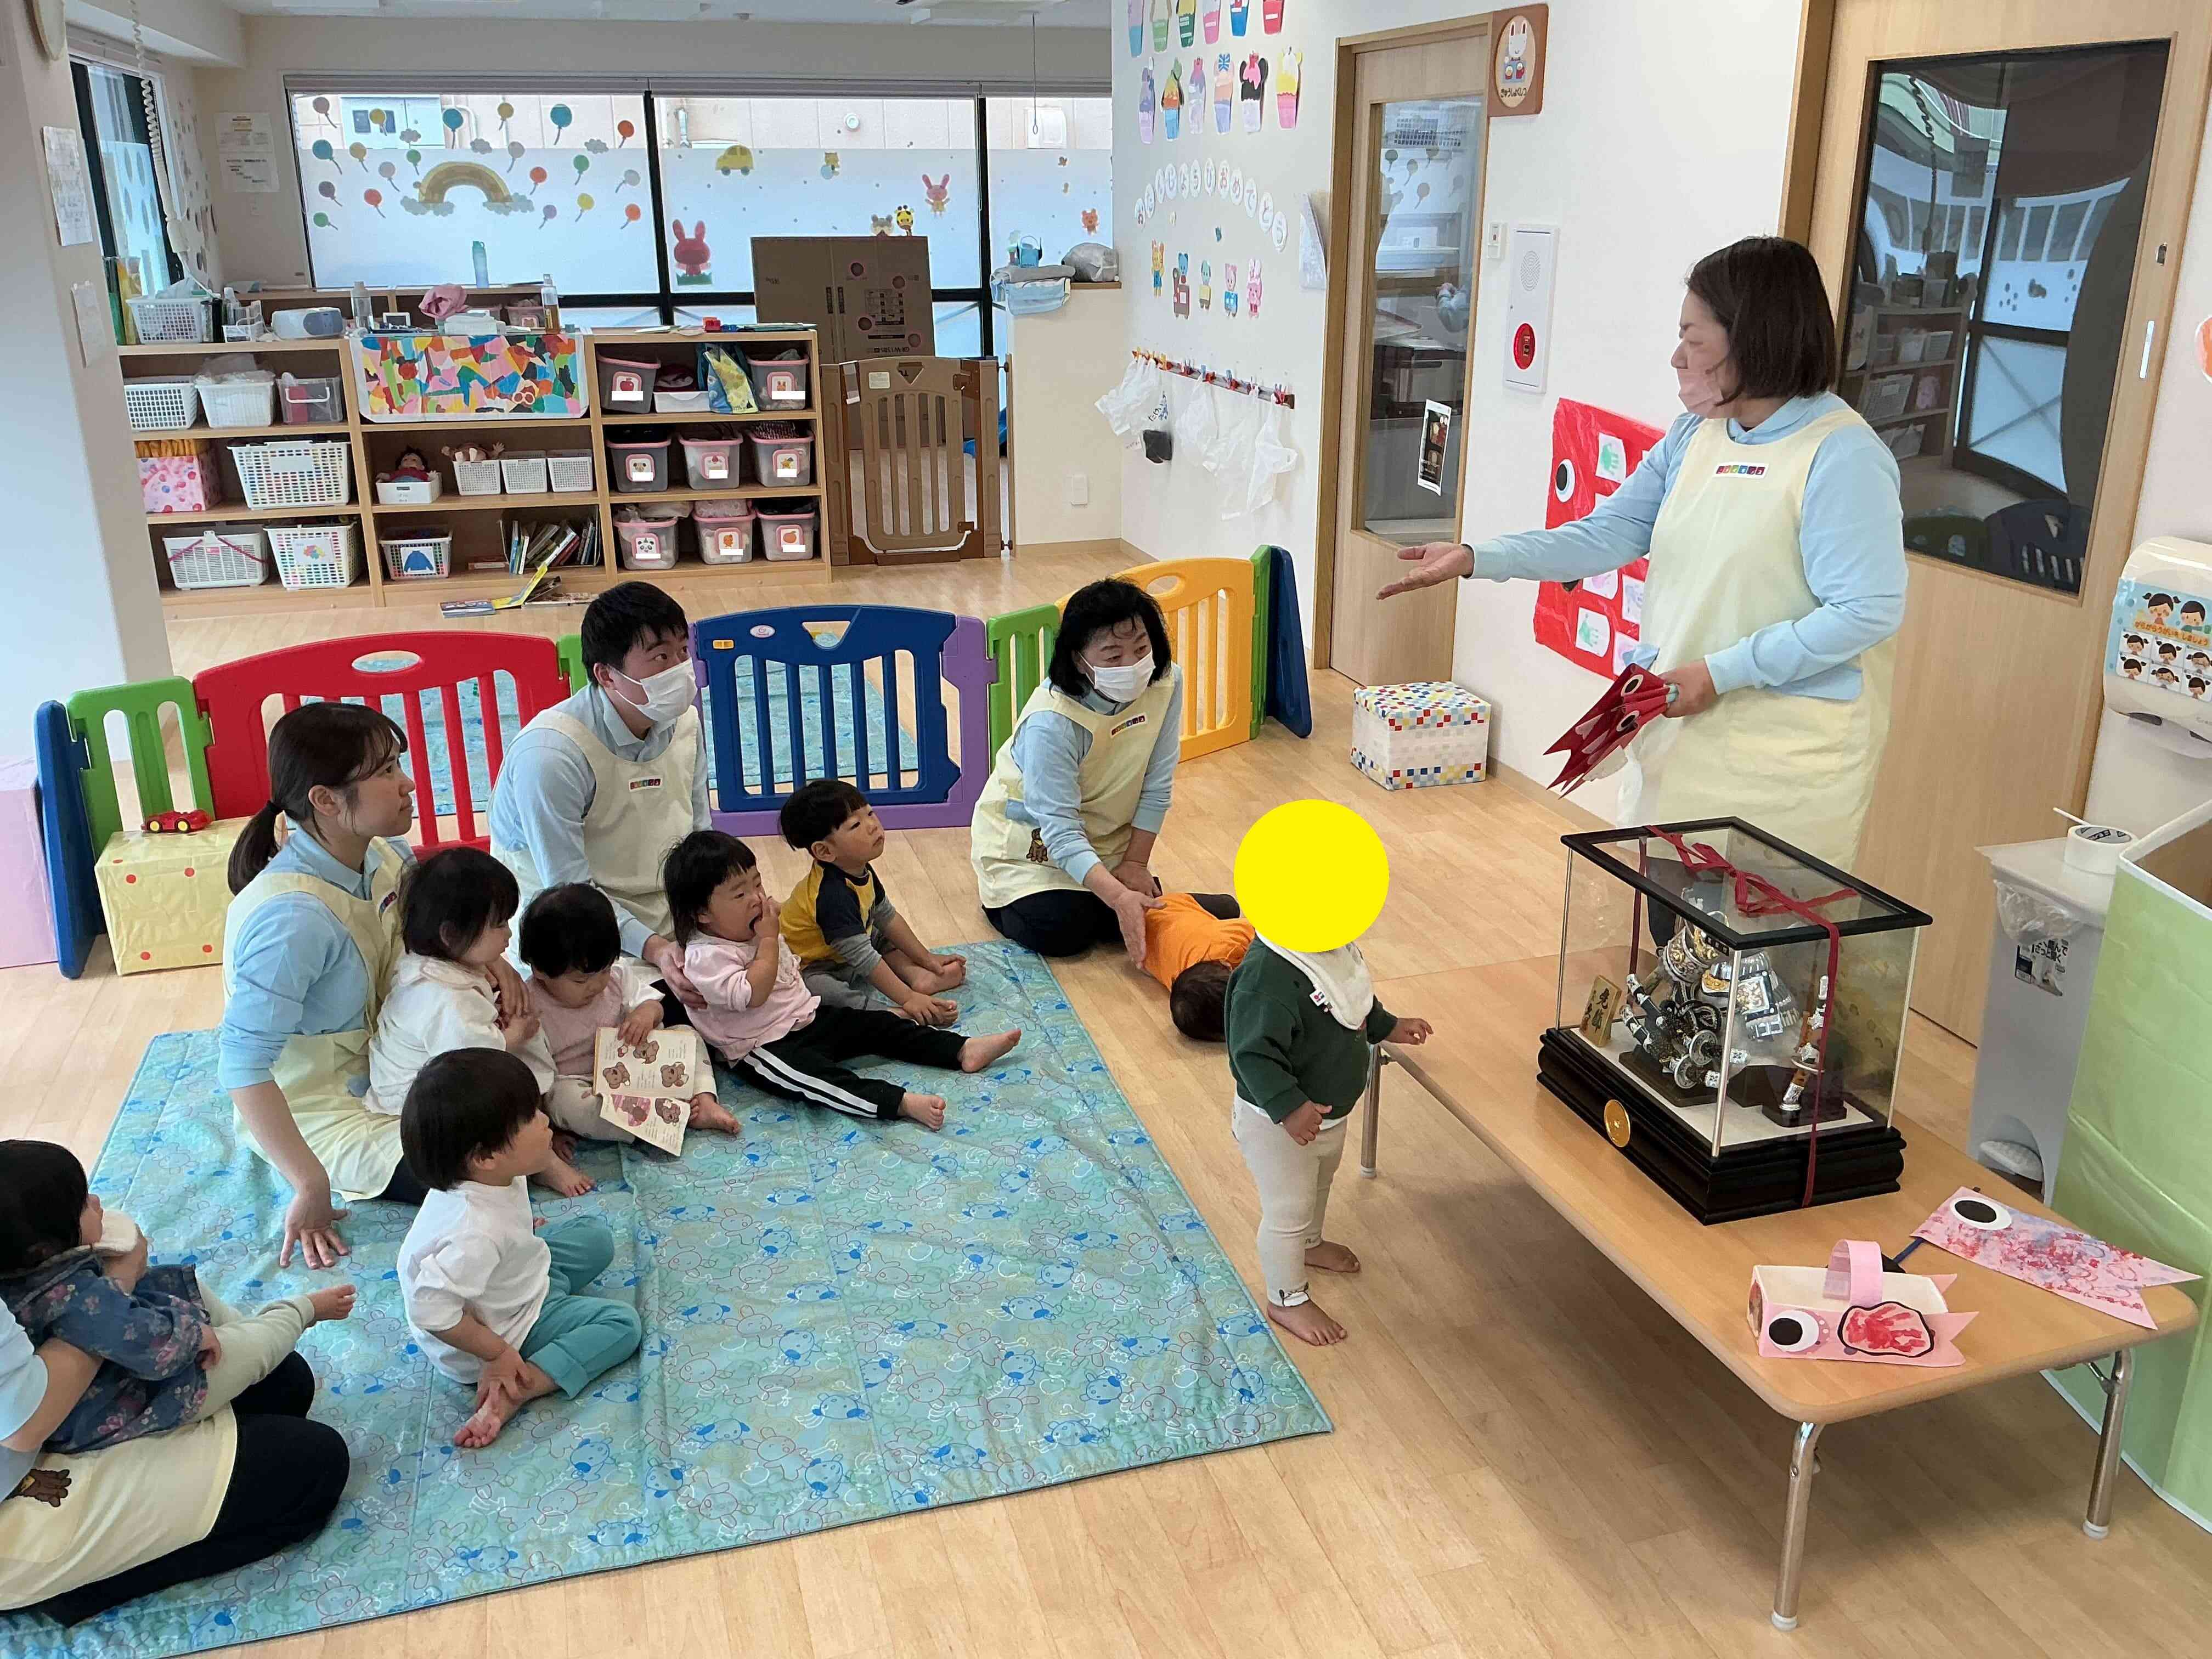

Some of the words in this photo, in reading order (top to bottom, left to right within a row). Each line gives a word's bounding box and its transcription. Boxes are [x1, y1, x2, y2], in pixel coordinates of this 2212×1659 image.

[1500, 88, 1527, 98] きゅうしょくしつ
